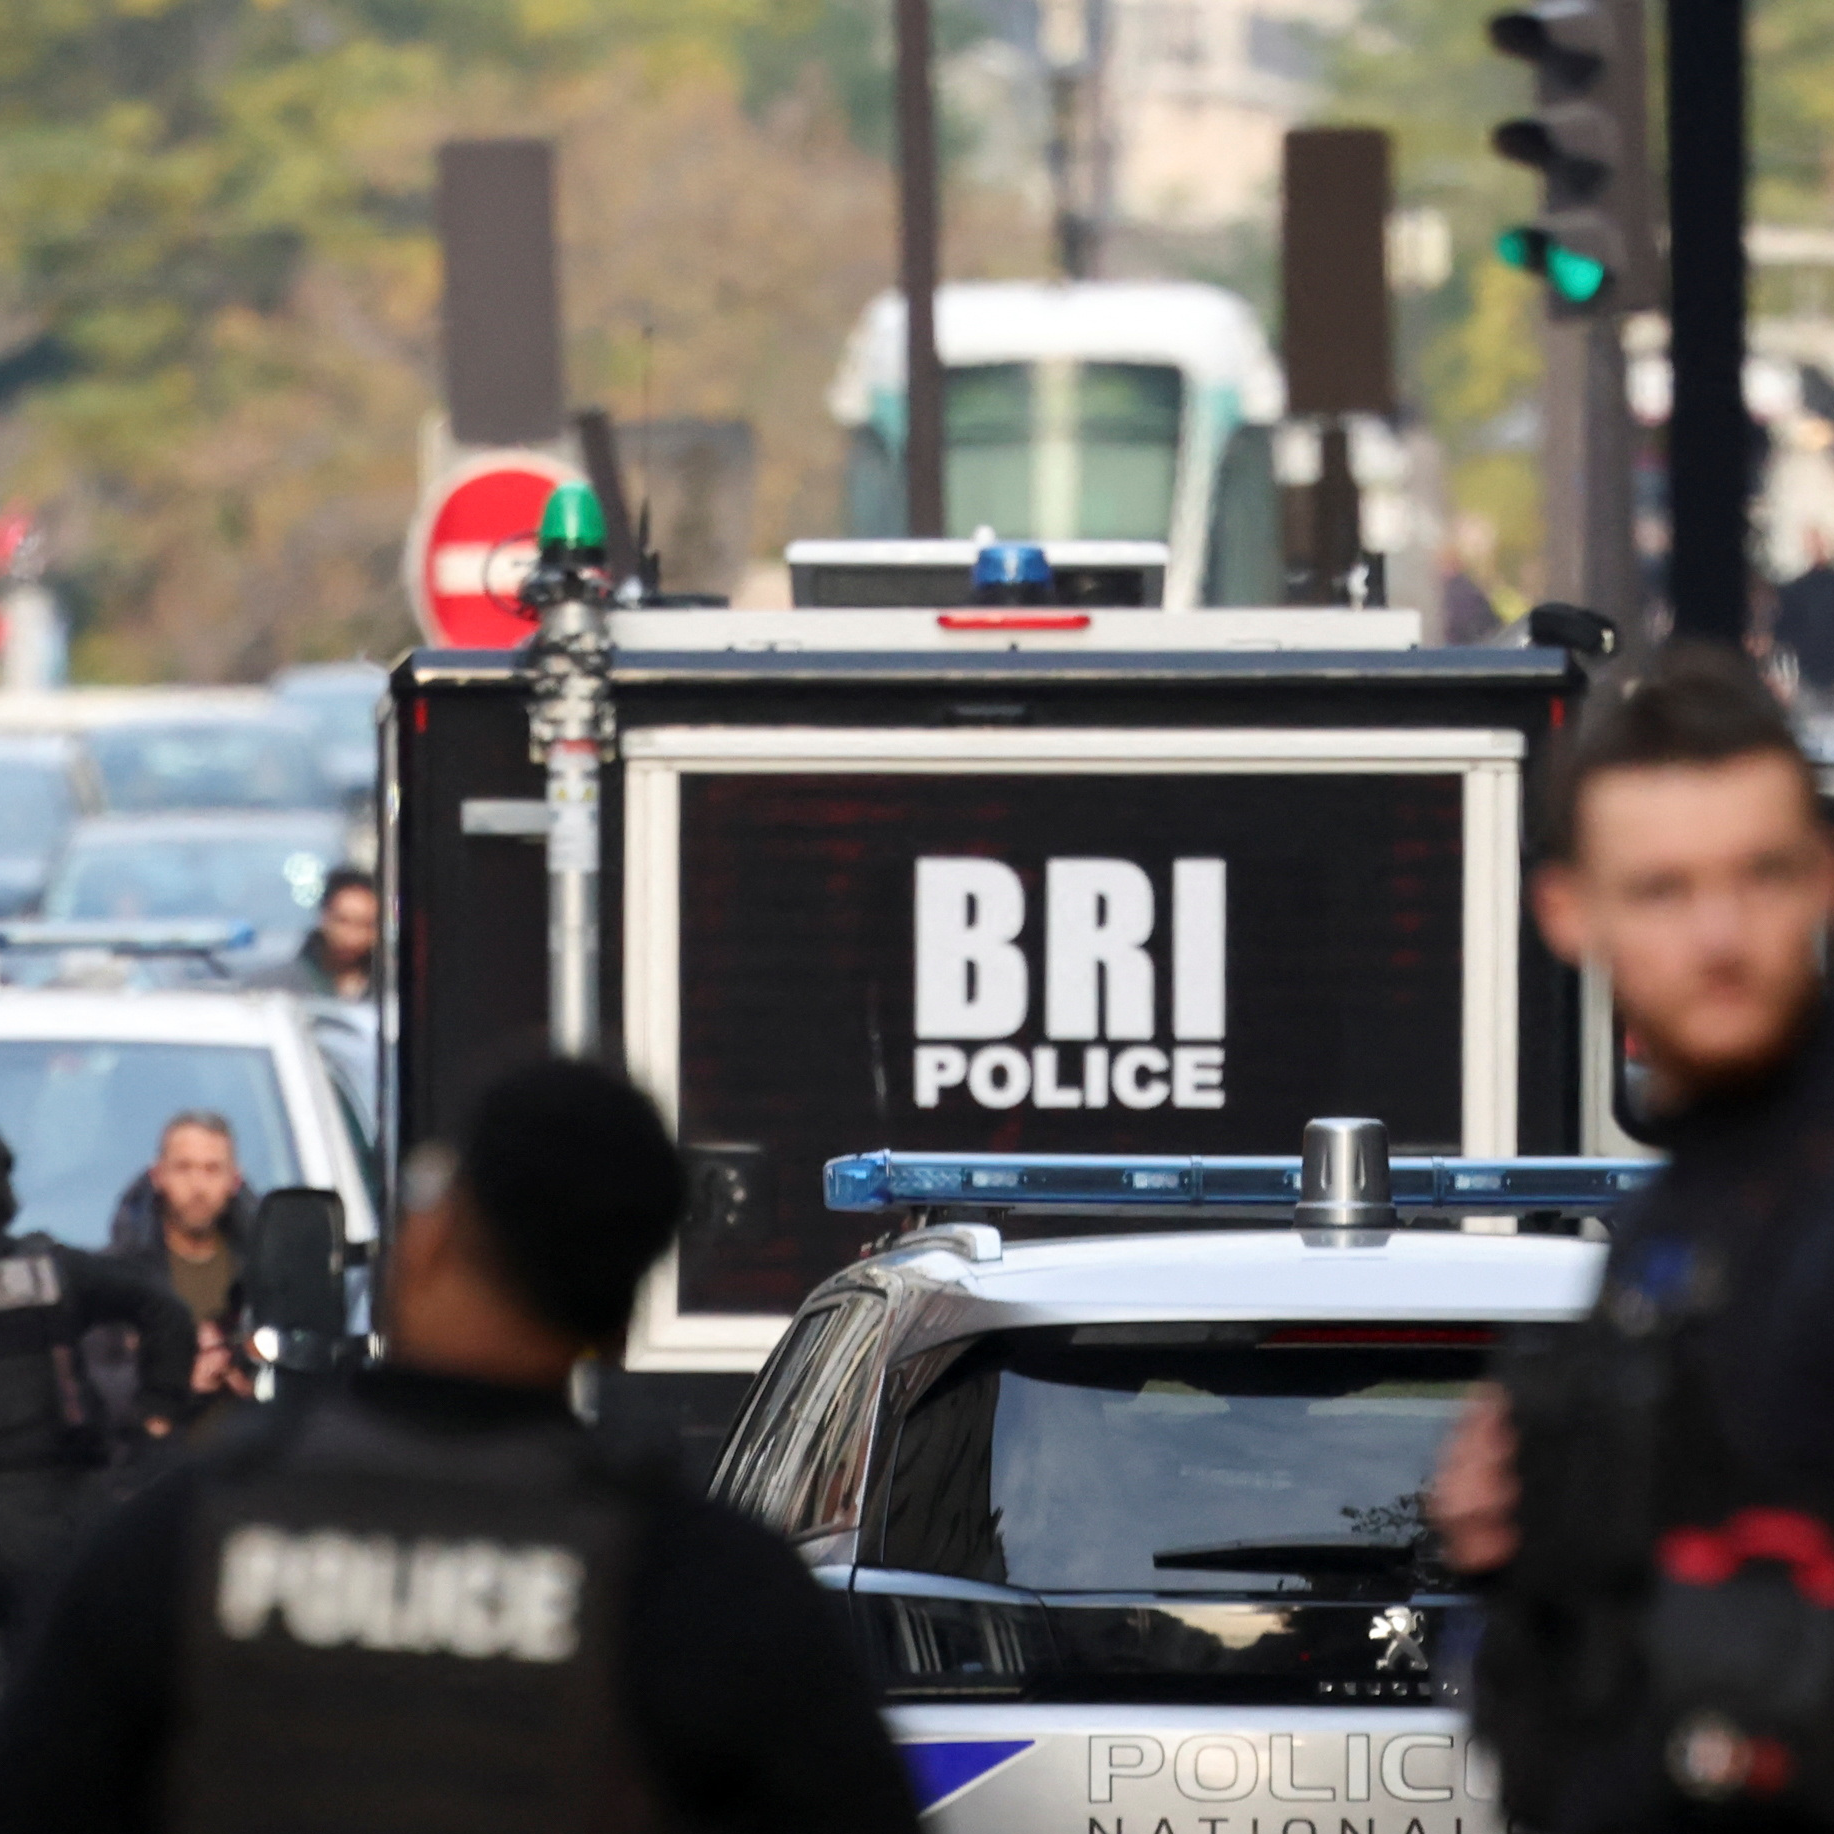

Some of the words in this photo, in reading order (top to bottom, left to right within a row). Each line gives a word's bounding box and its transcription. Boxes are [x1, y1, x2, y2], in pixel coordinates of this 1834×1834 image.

[914, 856, 1226, 1042] BRI
[913, 1045, 1226, 1110] POLICE
[219, 1524, 586, 1663] POLICE
